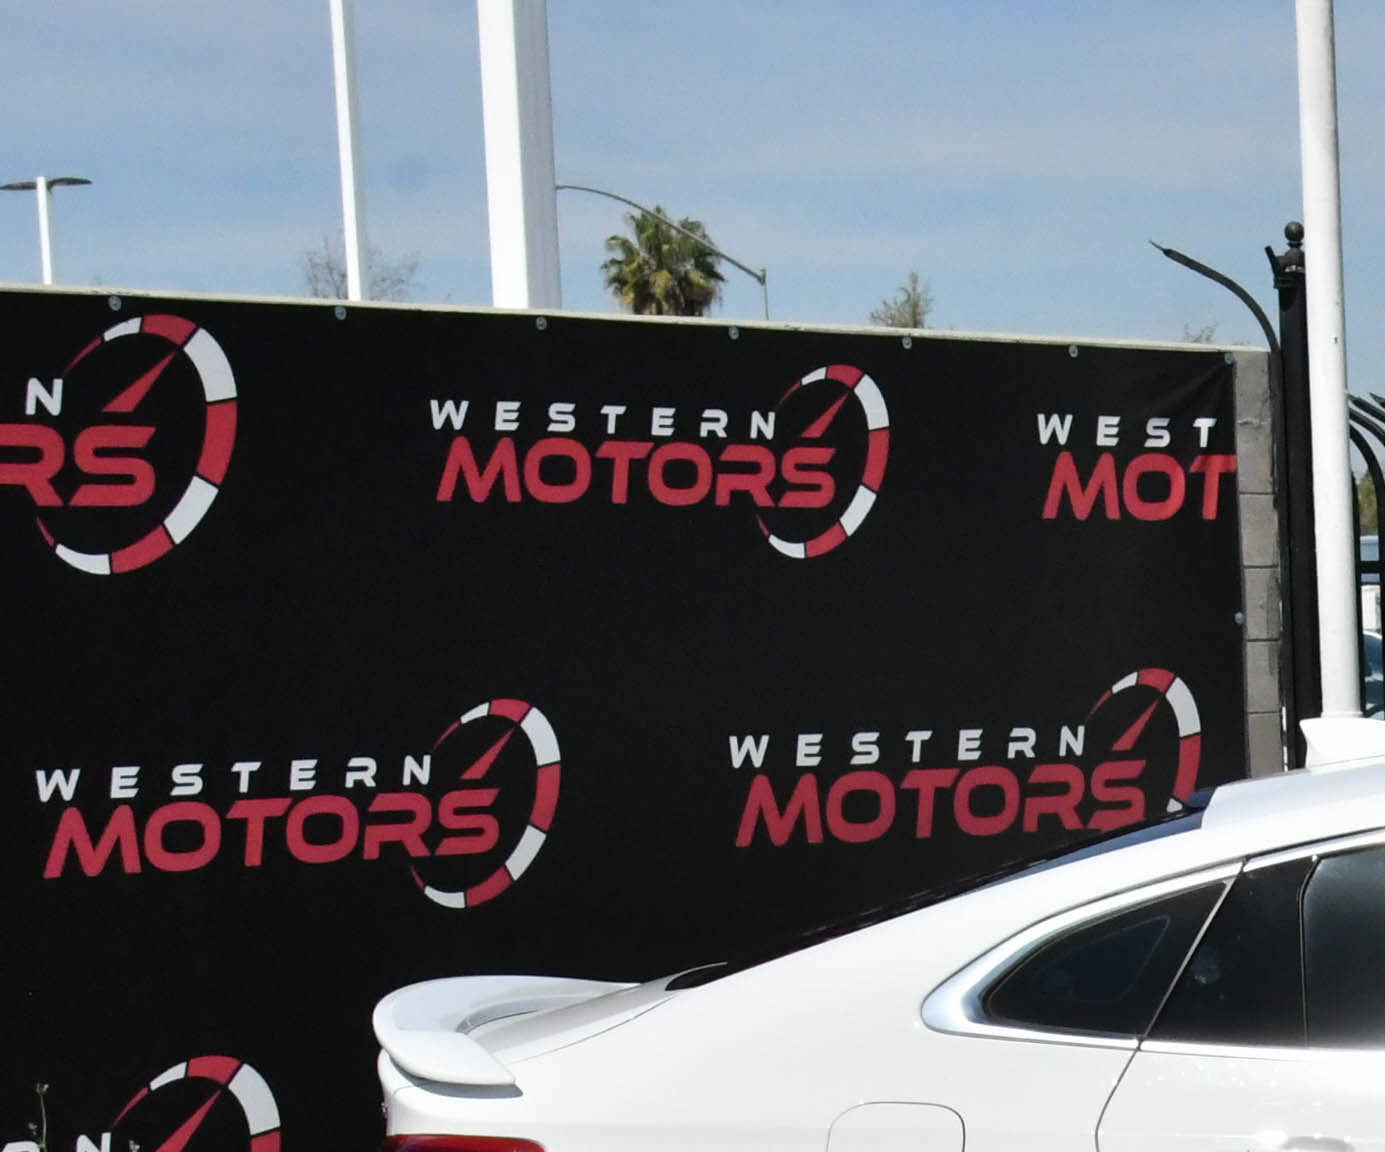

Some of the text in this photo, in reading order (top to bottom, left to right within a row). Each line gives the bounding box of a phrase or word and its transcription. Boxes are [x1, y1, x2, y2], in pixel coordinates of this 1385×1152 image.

[430, 399, 776, 440] WESTERN
[1037, 413, 1217, 448] WEST
[436, 436, 836, 509] MOTORS
[1042, 450, 1238, 521] MOT
[729, 725, 1085, 769] WESTERN
[35, 754, 431, 803] WESTERN
[735, 759, 1146, 847] MOTORS
[43, 788, 500, 879] MOTORS
